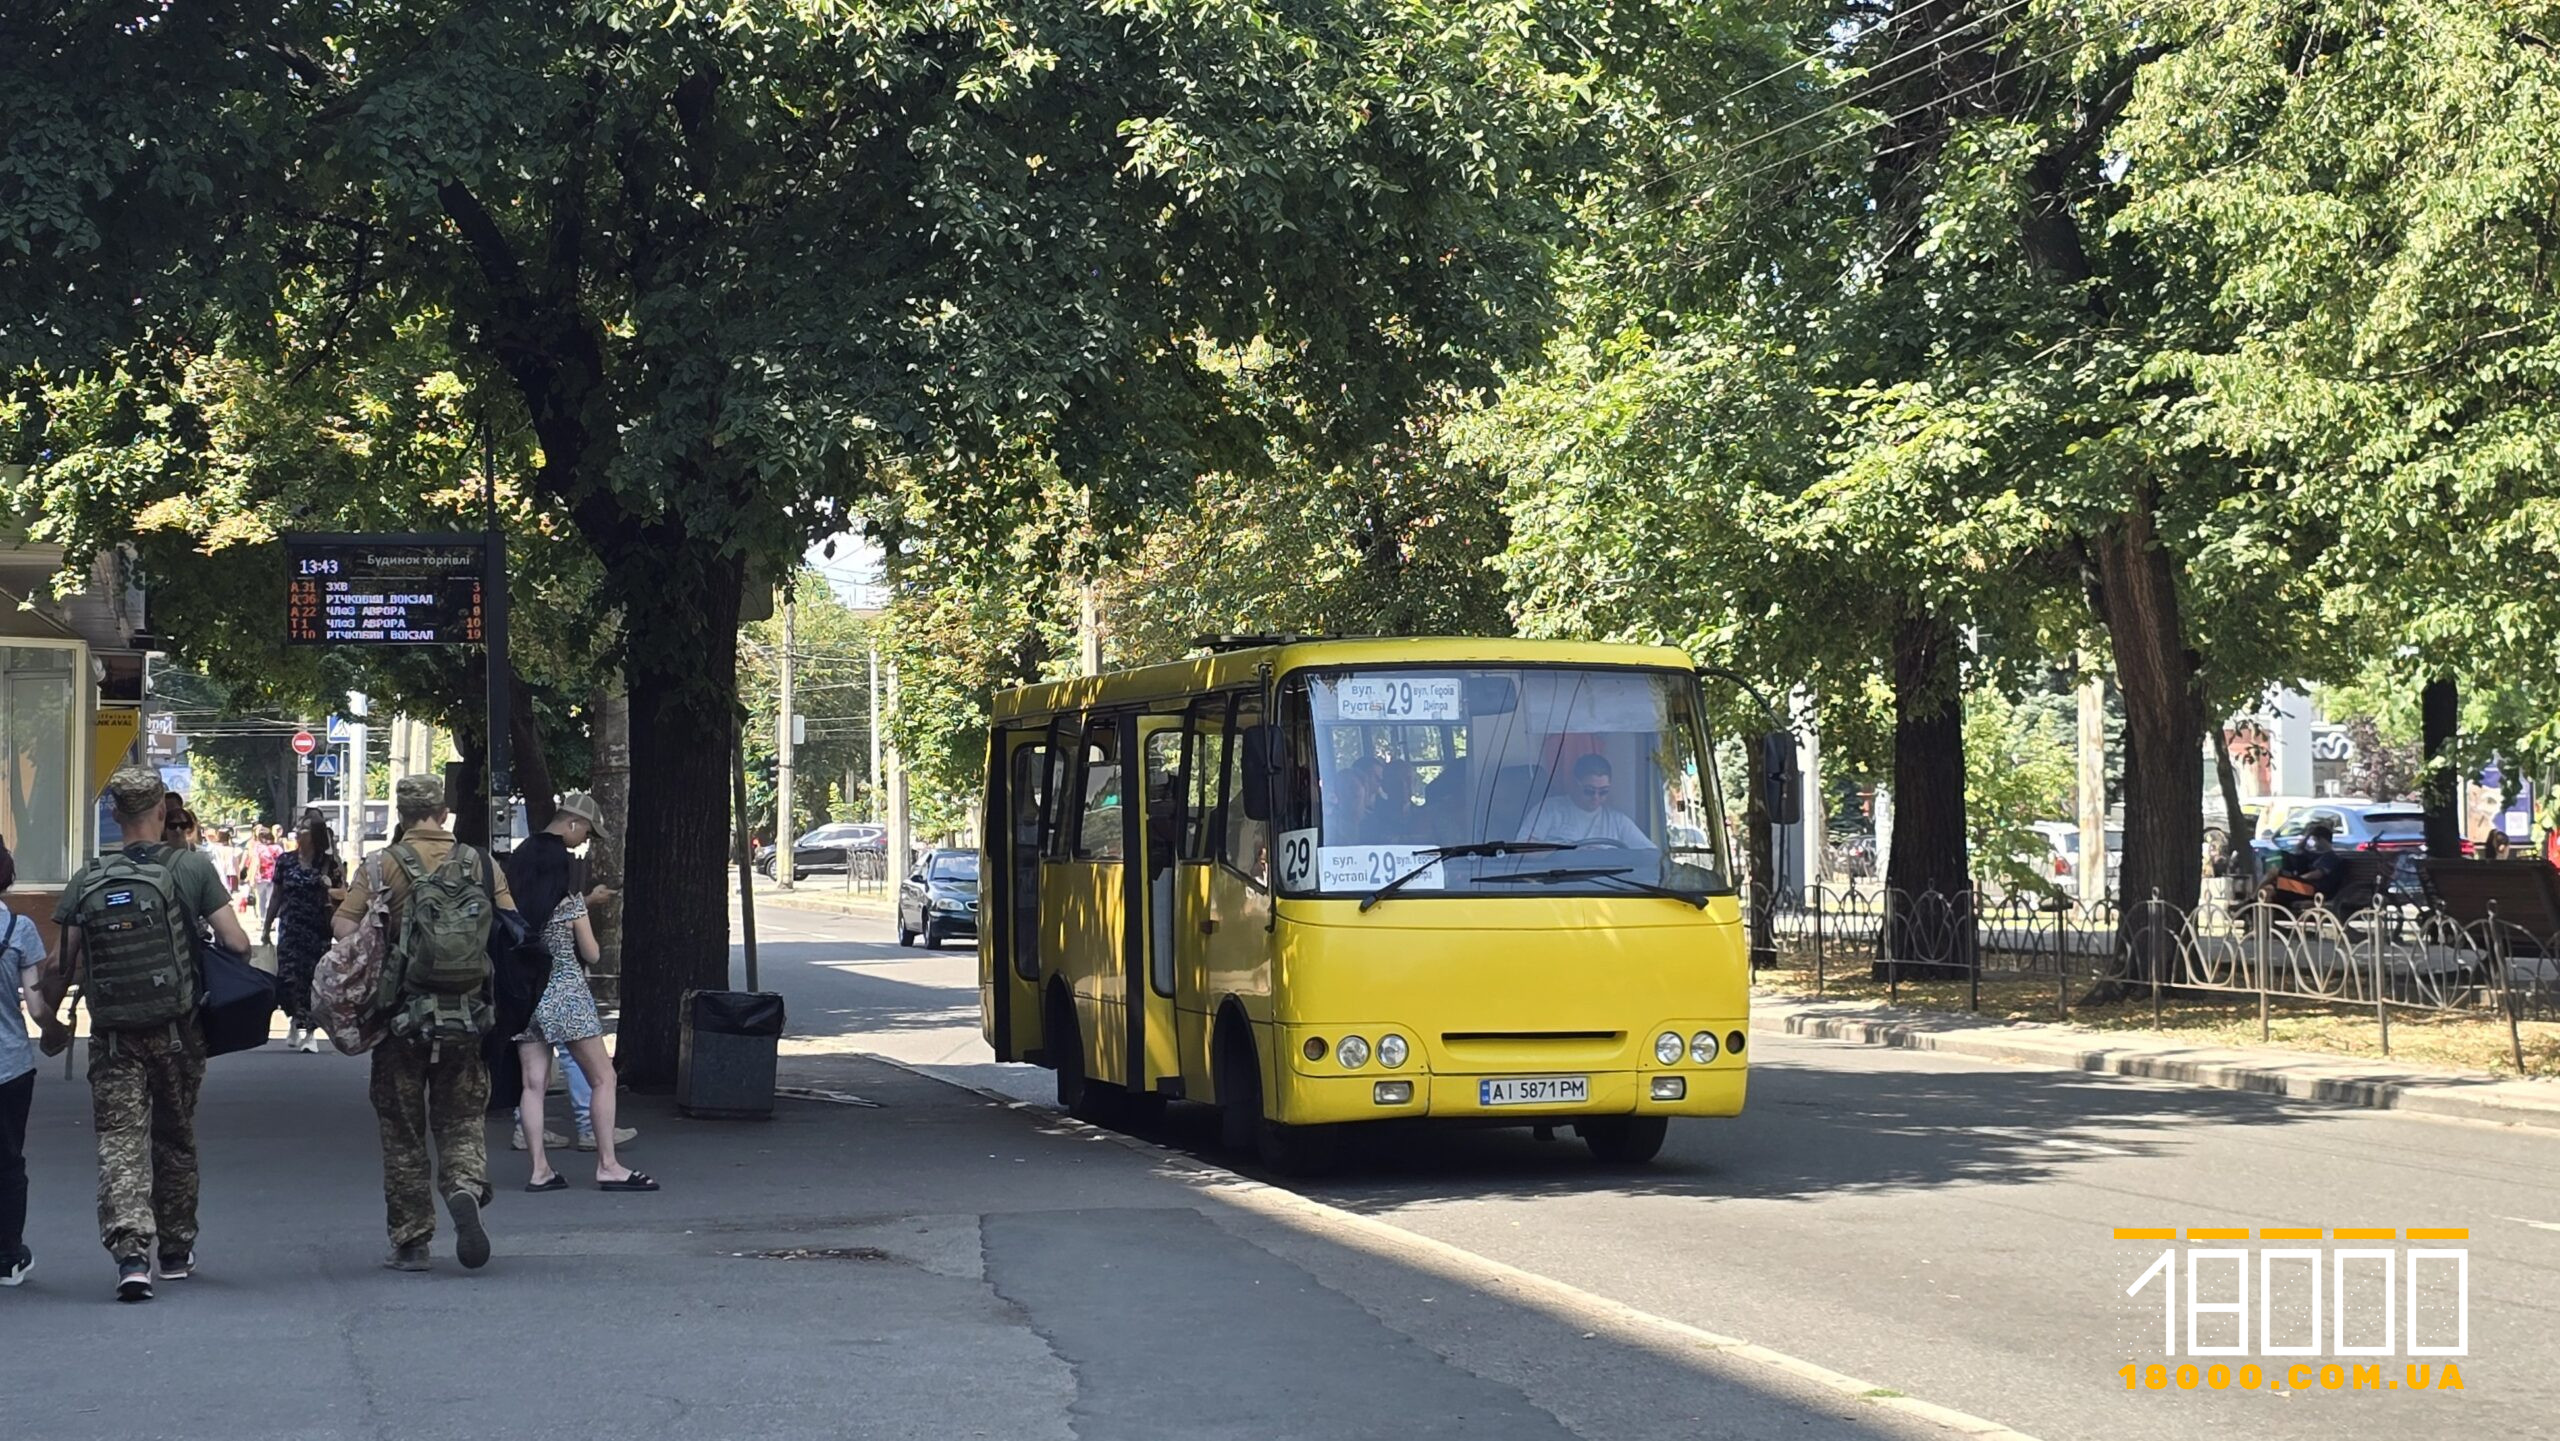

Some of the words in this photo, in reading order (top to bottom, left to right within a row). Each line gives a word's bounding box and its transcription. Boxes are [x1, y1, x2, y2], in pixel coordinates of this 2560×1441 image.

[299, 559, 339, 575] 13:43
[367, 554, 420, 567] Будинок
[422, 554, 470, 567] торгівлі
[302, 582, 316, 592] 31
[473, 582, 480, 592] 3
[302, 594, 316, 604] 36
[390, 594, 433, 604] ВОКЗАЛ
[473, 593, 481, 604] 8
[302, 606, 317, 617] 22
[362, 606, 406, 616] АВРОРА
[473, 605, 481, 616] 9
[302, 618, 309, 629] 1
[362, 618, 406, 628] АВРОРА
[465, 617, 481, 628] 10
[302, 630, 316, 639] 10
[390, 630, 434, 640] ВОКЗАЛ
[466, 629, 481, 640] 19
[1352, 685, 1375, 698] вул.
[1386, 682, 1413, 715] 29
[1285, 837, 1310, 881] 29
[1332, 856, 1357, 868] вул.
[1368, 851, 1397, 885] 29
[1323, 870, 1368, 886] Руставі
[1493, 1083, 1512, 1100] AI
[1520, 1082, 1555, 1098] 5871
[1560, 1080, 1584, 1097] PM
